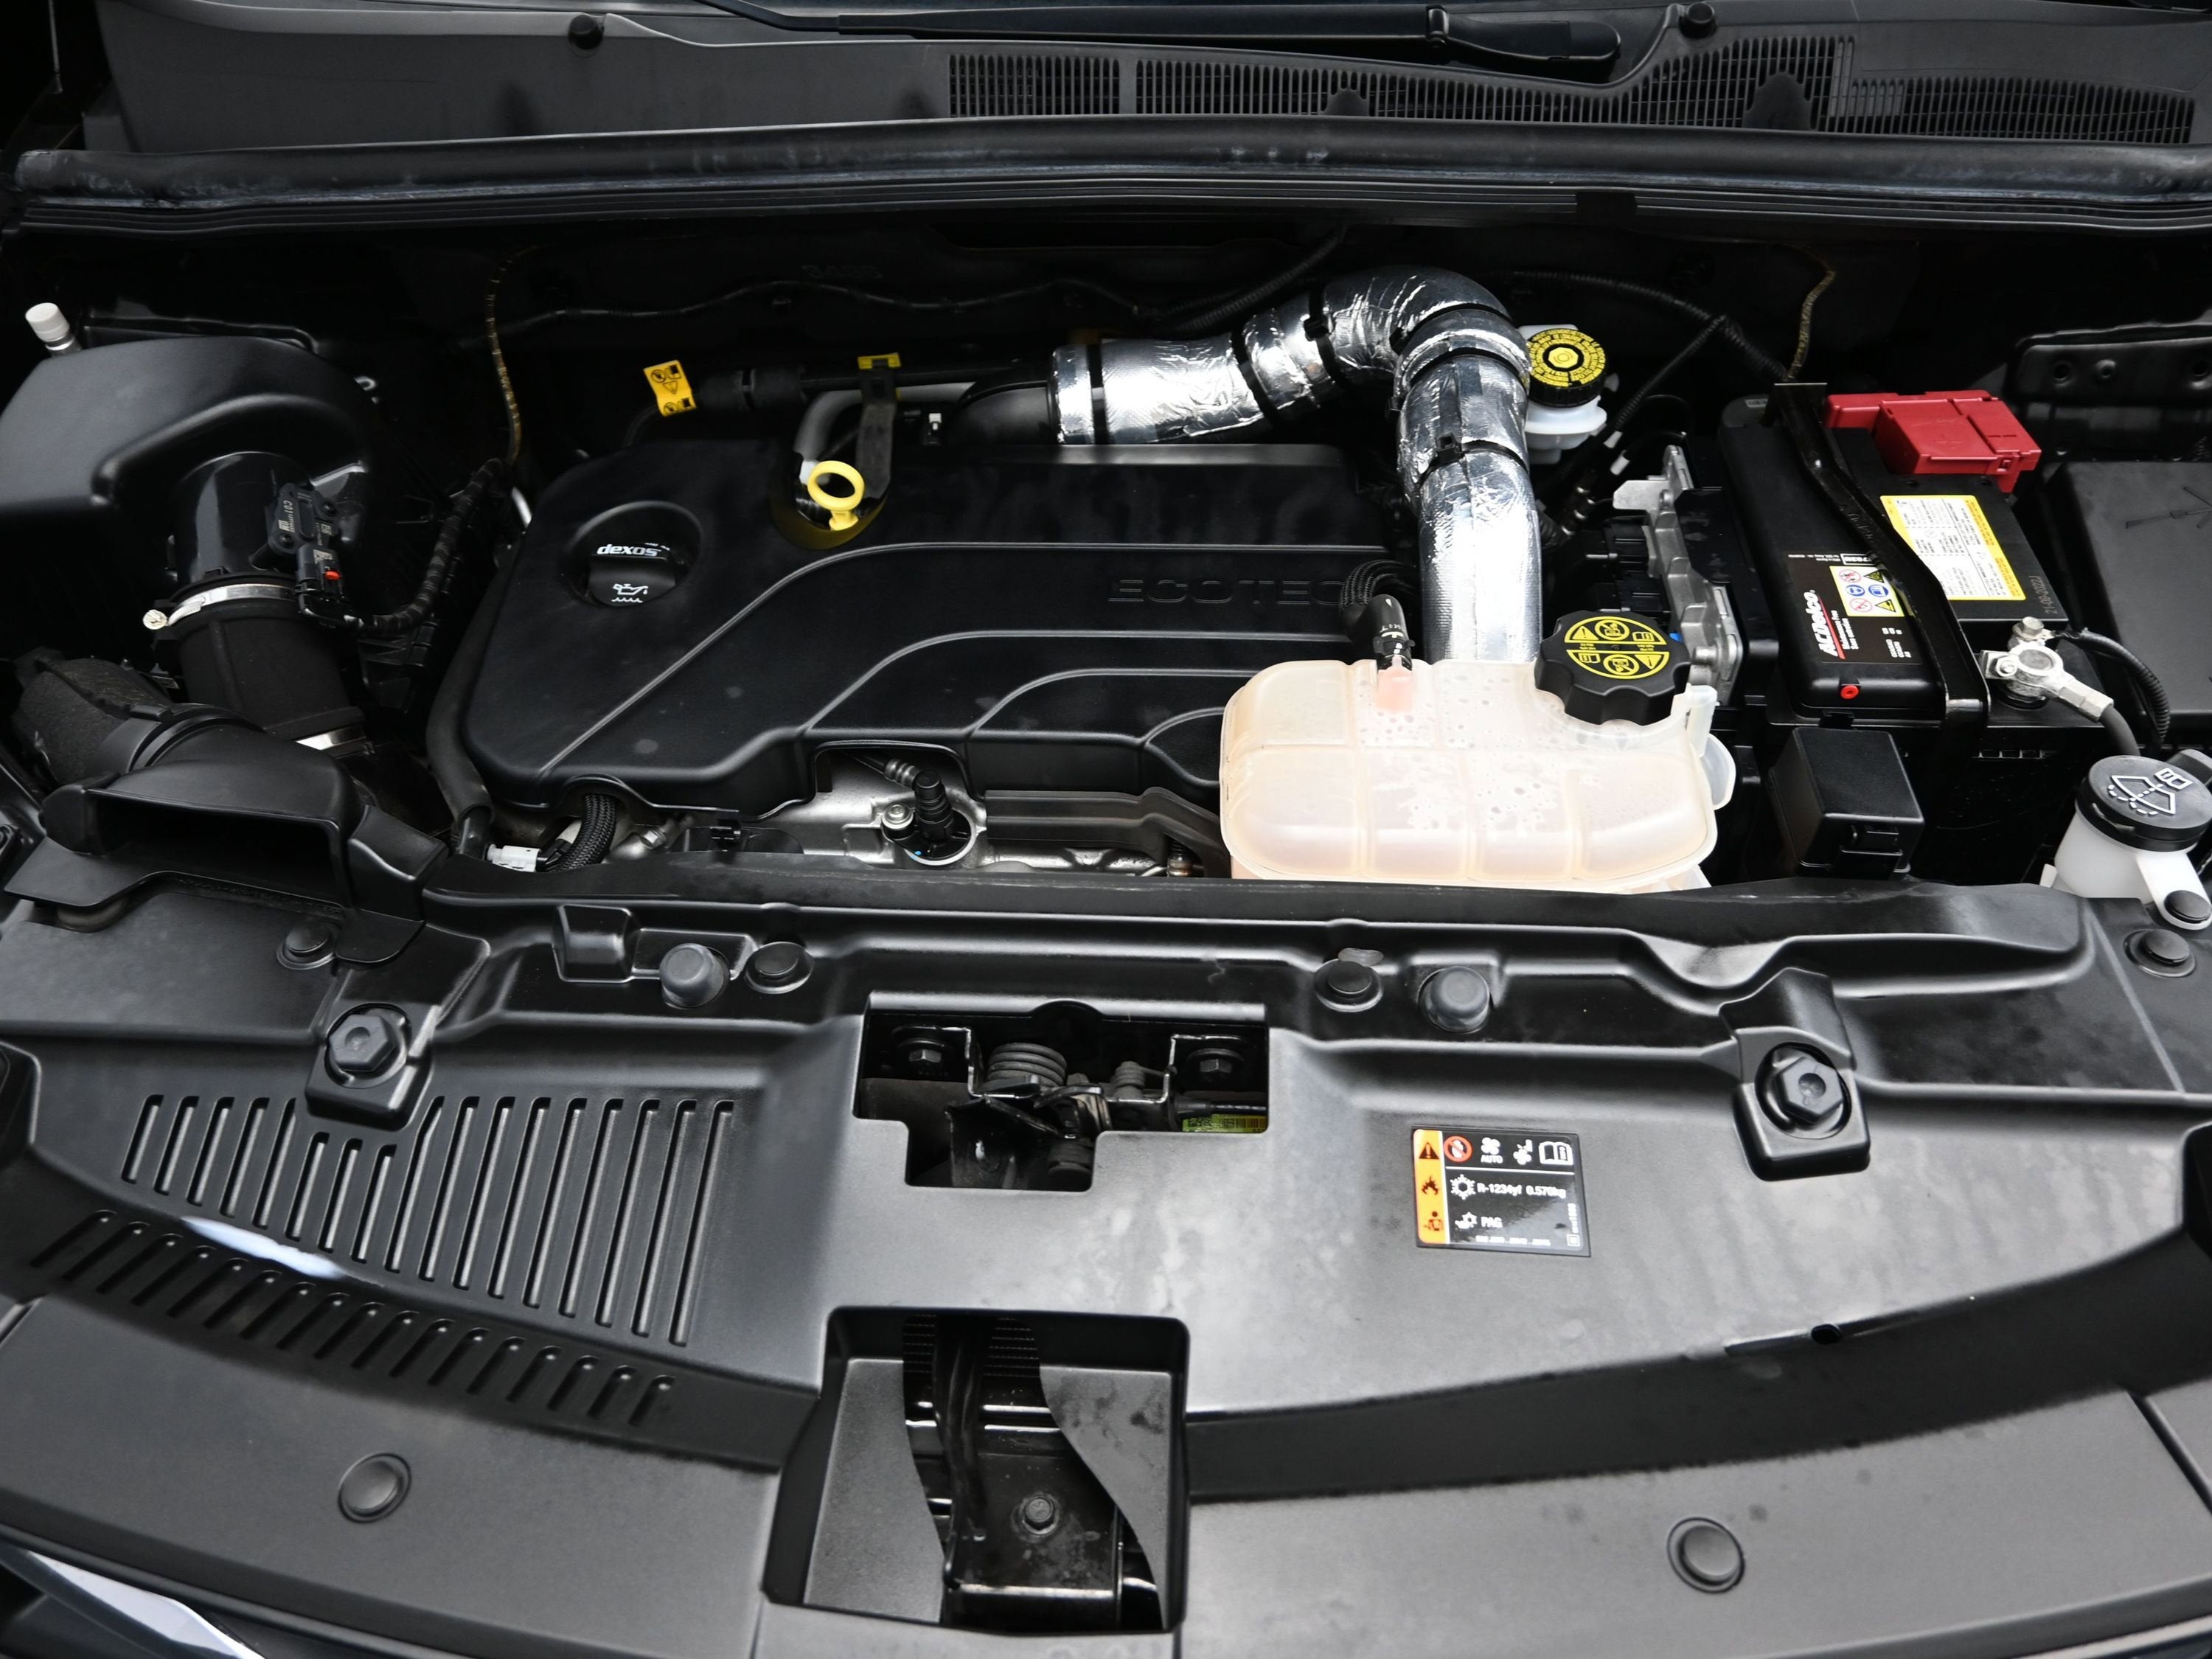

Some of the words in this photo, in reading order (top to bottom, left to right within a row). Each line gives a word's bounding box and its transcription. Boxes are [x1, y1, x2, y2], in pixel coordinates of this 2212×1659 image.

[597, 544, 661, 557] dexos
[1481, 1155, 1503, 1164] AUTO
[1481, 1217, 1503, 1228] PAG
